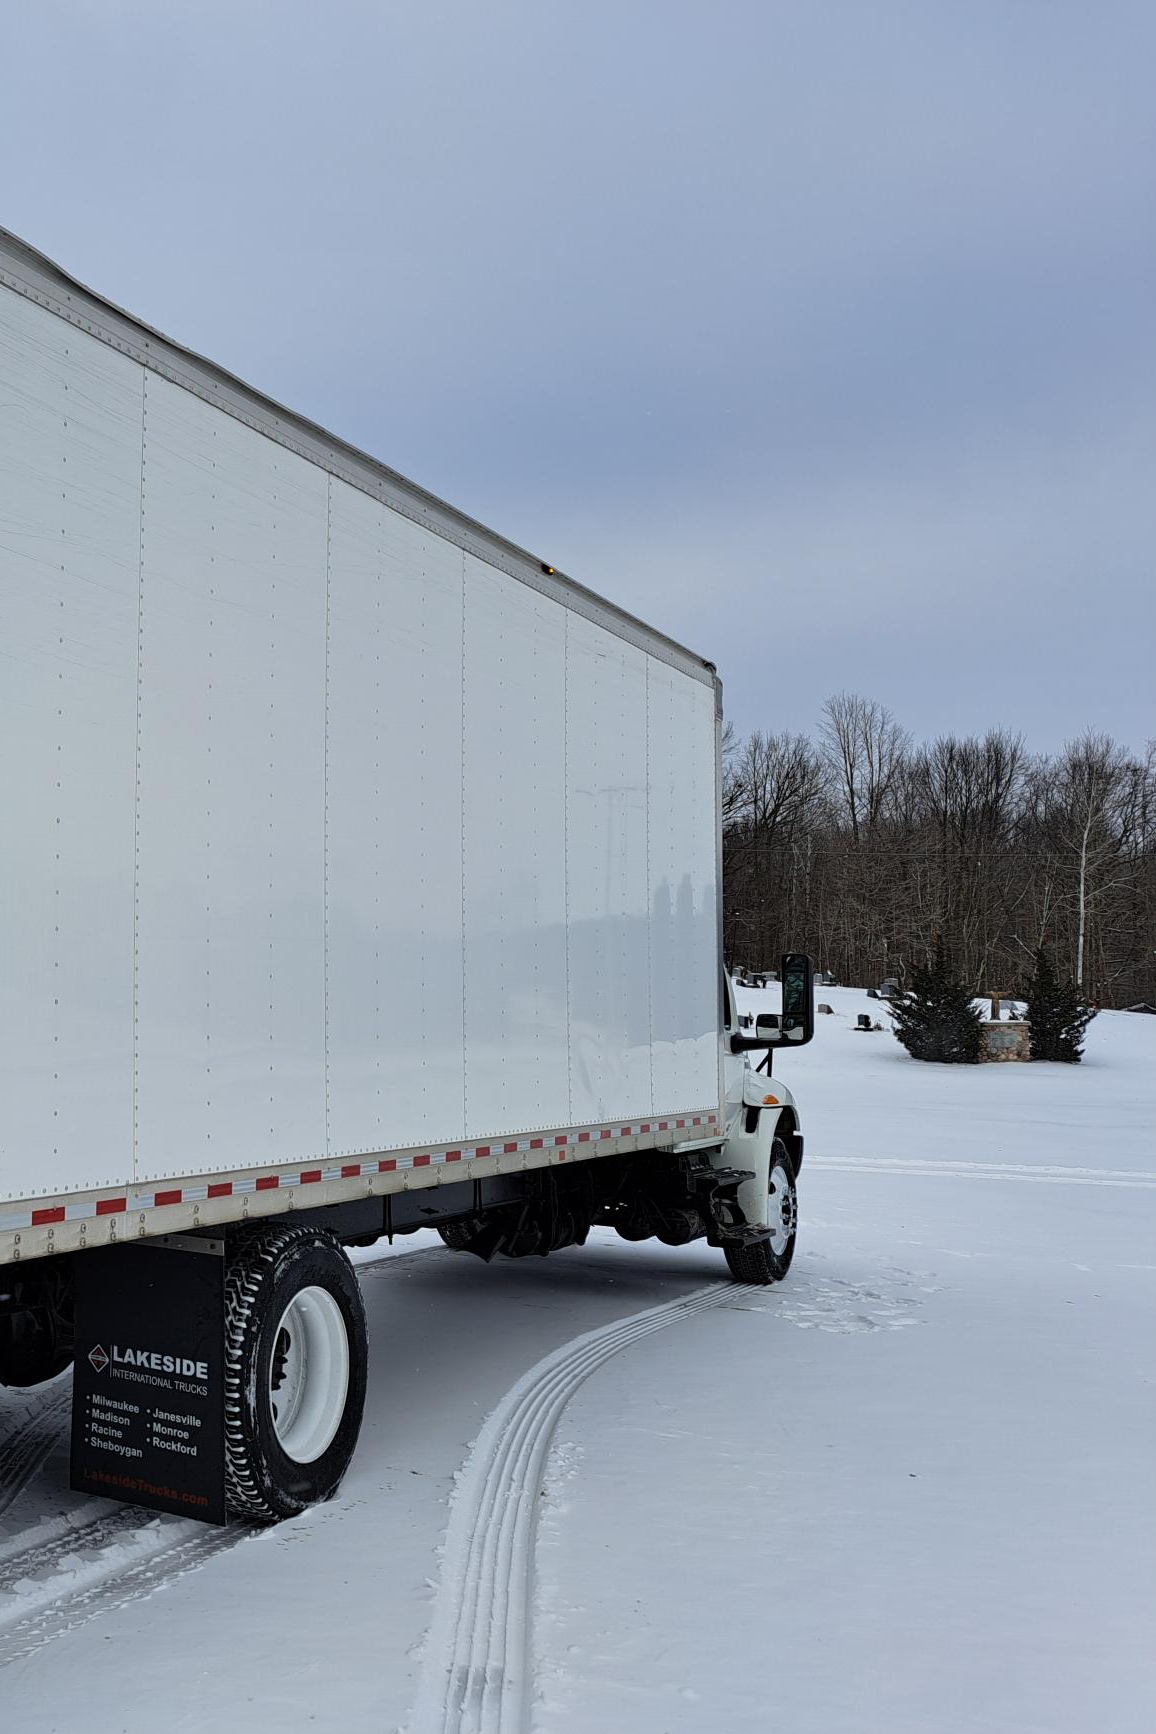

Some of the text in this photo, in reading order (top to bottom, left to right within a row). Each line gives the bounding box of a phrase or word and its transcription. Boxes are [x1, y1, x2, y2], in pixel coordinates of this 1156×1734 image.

[112, 1345, 209, 1380] LAKESIDE
[112, 1368, 208, 1396] INTERNATIONAL TRUCKS
[92, 1393, 140, 1414] Milwaukee
[91, 1408, 131, 1426] Madison
[152, 1408, 202, 1427] Janesville
[91, 1423, 123, 1439] Racine
[152, 1423, 190, 1440] Monroe
[90, 1436, 143, 1458] Sheboygan
[152, 1437, 197, 1456] Rockford
[84, 1468, 209, 1506] LakesideTrucks.com
